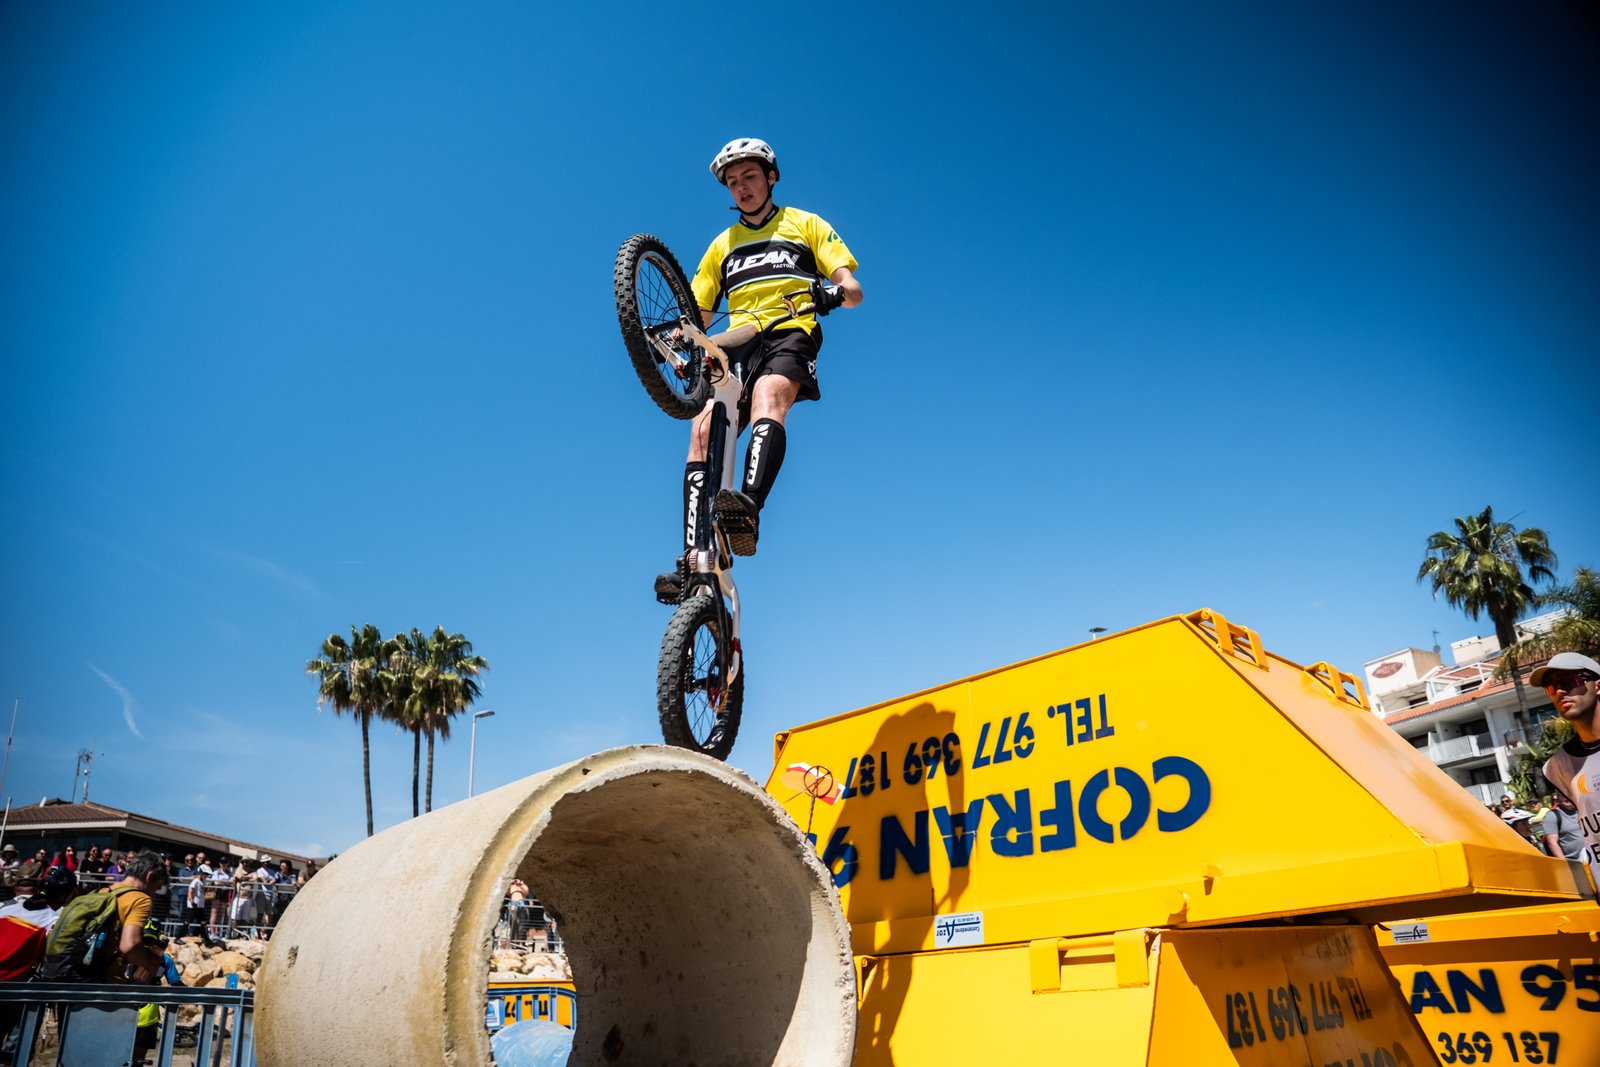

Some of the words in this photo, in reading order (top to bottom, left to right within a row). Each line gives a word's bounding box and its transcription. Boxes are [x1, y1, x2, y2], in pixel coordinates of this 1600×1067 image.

[726, 250, 800, 278] CLEAN
[745, 436, 763, 485] CLEAN
[686, 485, 700, 546] CLEAN
[971, 712, 1035, 769] 977
[1047, 693, 1115, 747] TEL.
[842, 752, 891, 800] 187
[904, 732, 961, 785] 369
[879, 755, 1212, 880] COFRAN
[1580, 810, 1600, 838] JU
[1226, 991, 1266, 1049] 187
[1267, 983, 1308, 1041] 369
[1438, 1031, 1493, 1065] 369
[1502, 1031, 1560, 1065] 187
